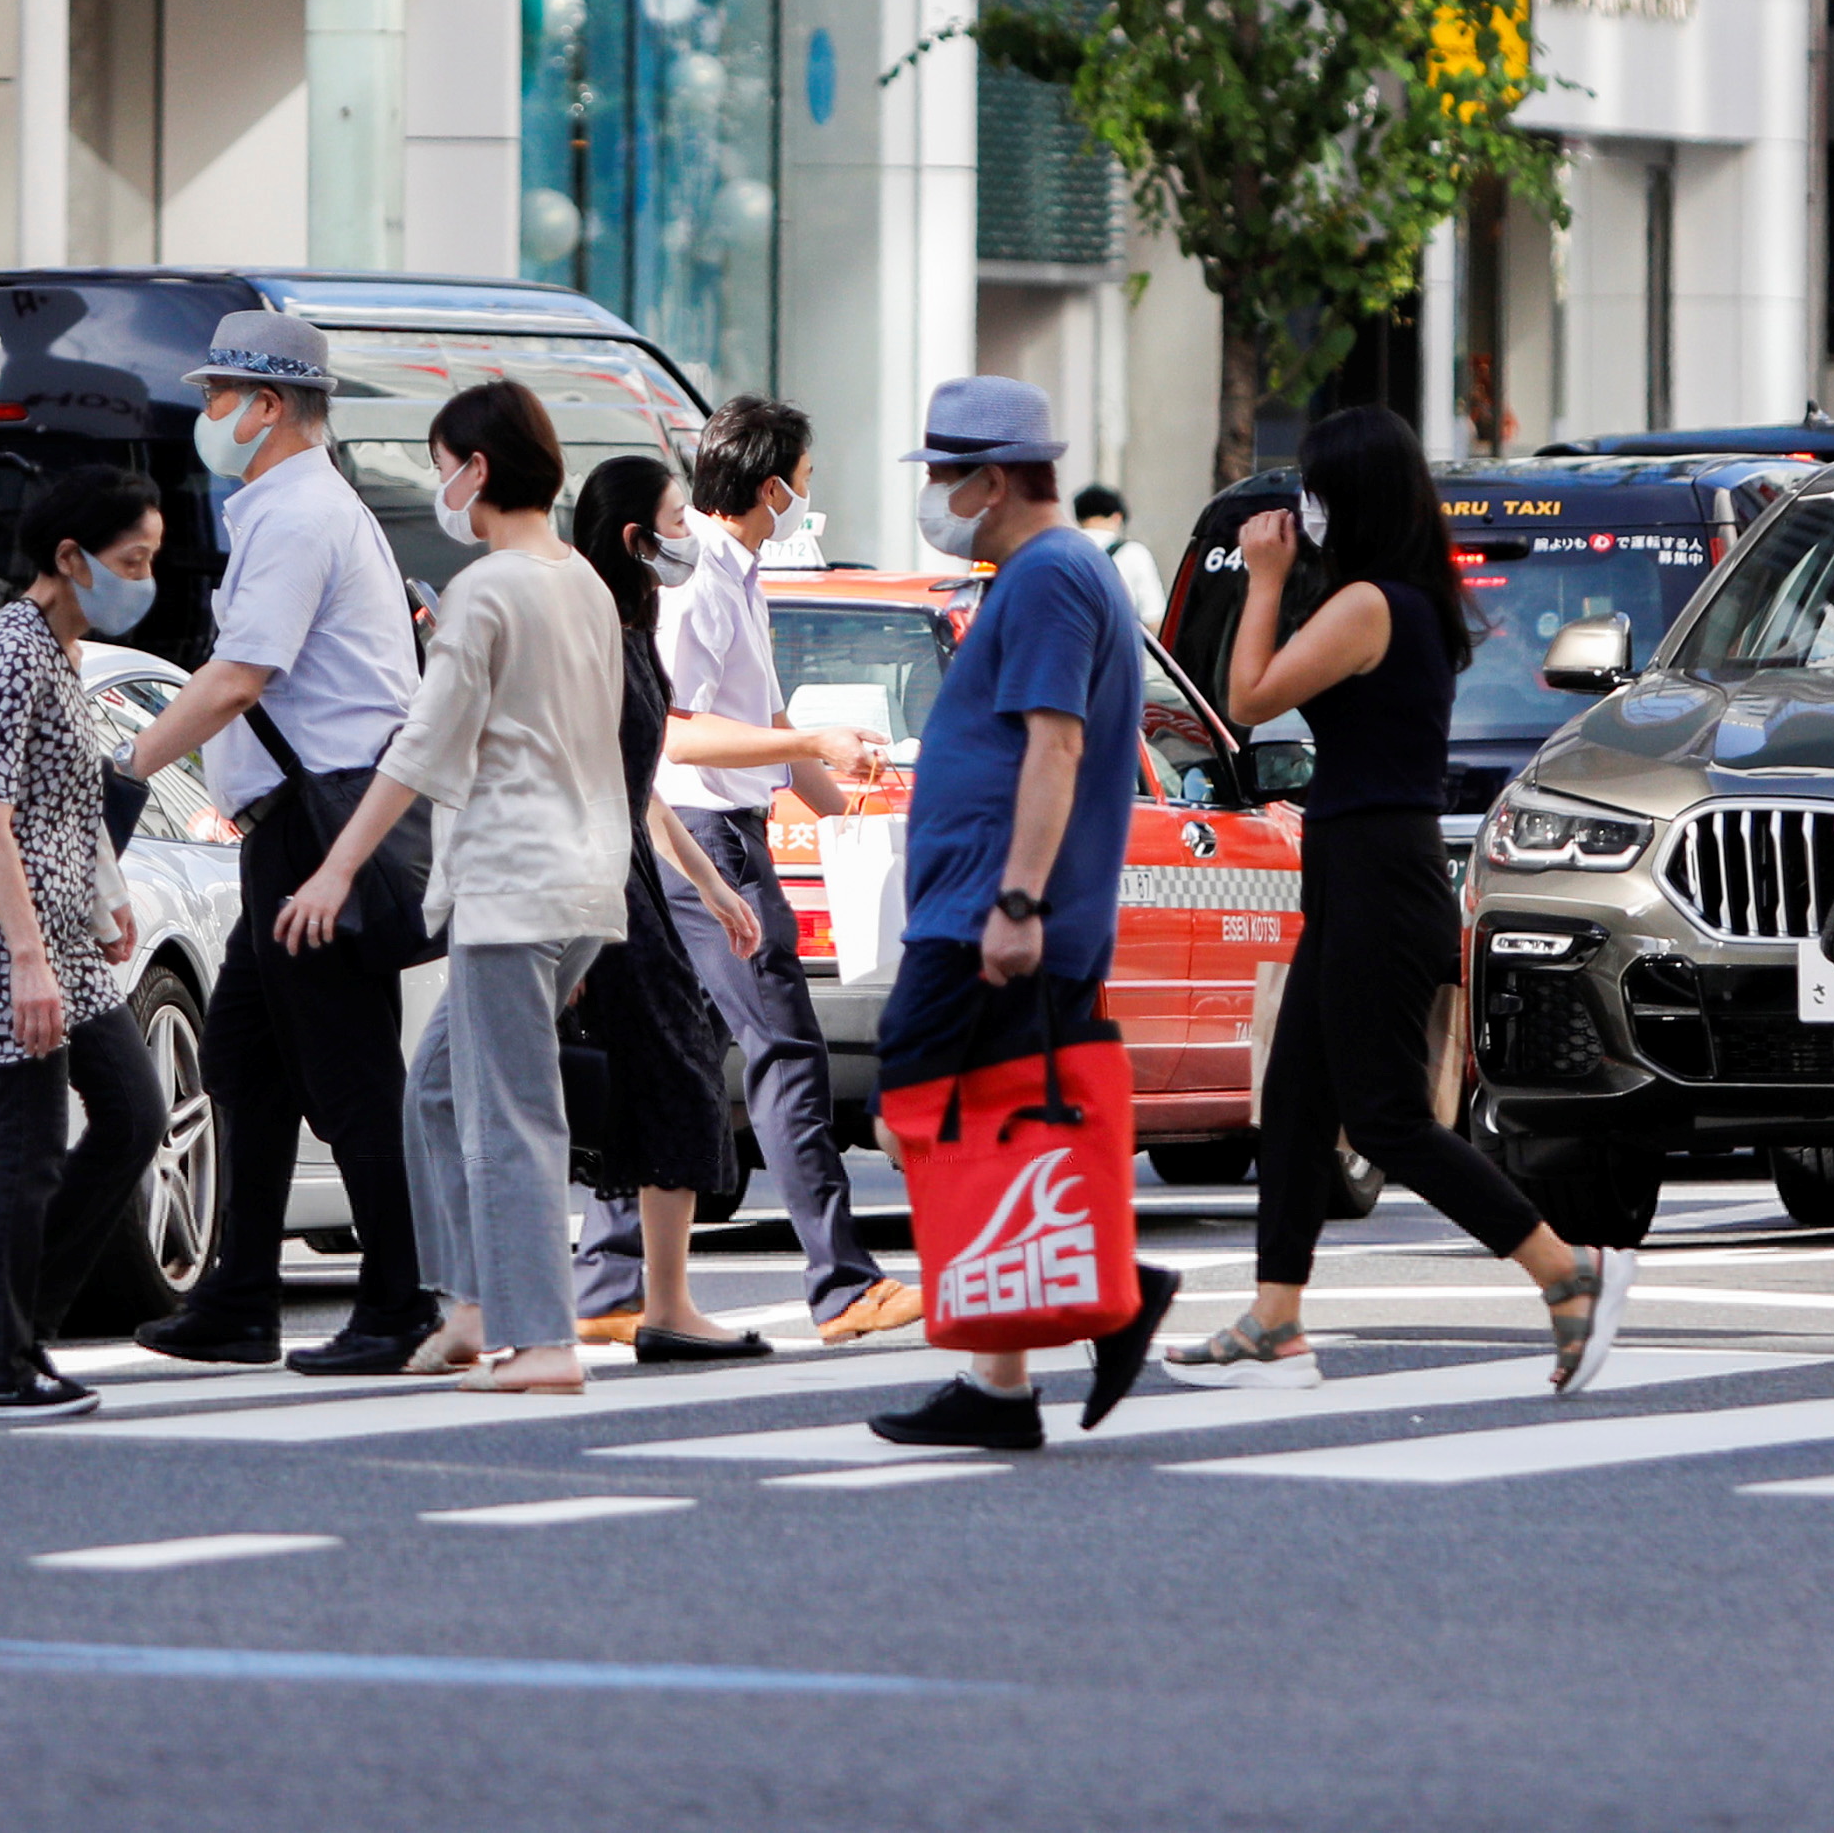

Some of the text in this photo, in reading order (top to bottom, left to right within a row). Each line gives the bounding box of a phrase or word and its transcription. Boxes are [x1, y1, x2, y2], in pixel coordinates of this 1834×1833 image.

[1503, 500, 1562, 516] TAXI
[1204, 546, 1249, 573] 64
[1222, 914, 1281, 943] EISEN KOTSU
[1812, 983, 1826, 1005] さ
[935, 1222, 1100, 1323] AEGIS
